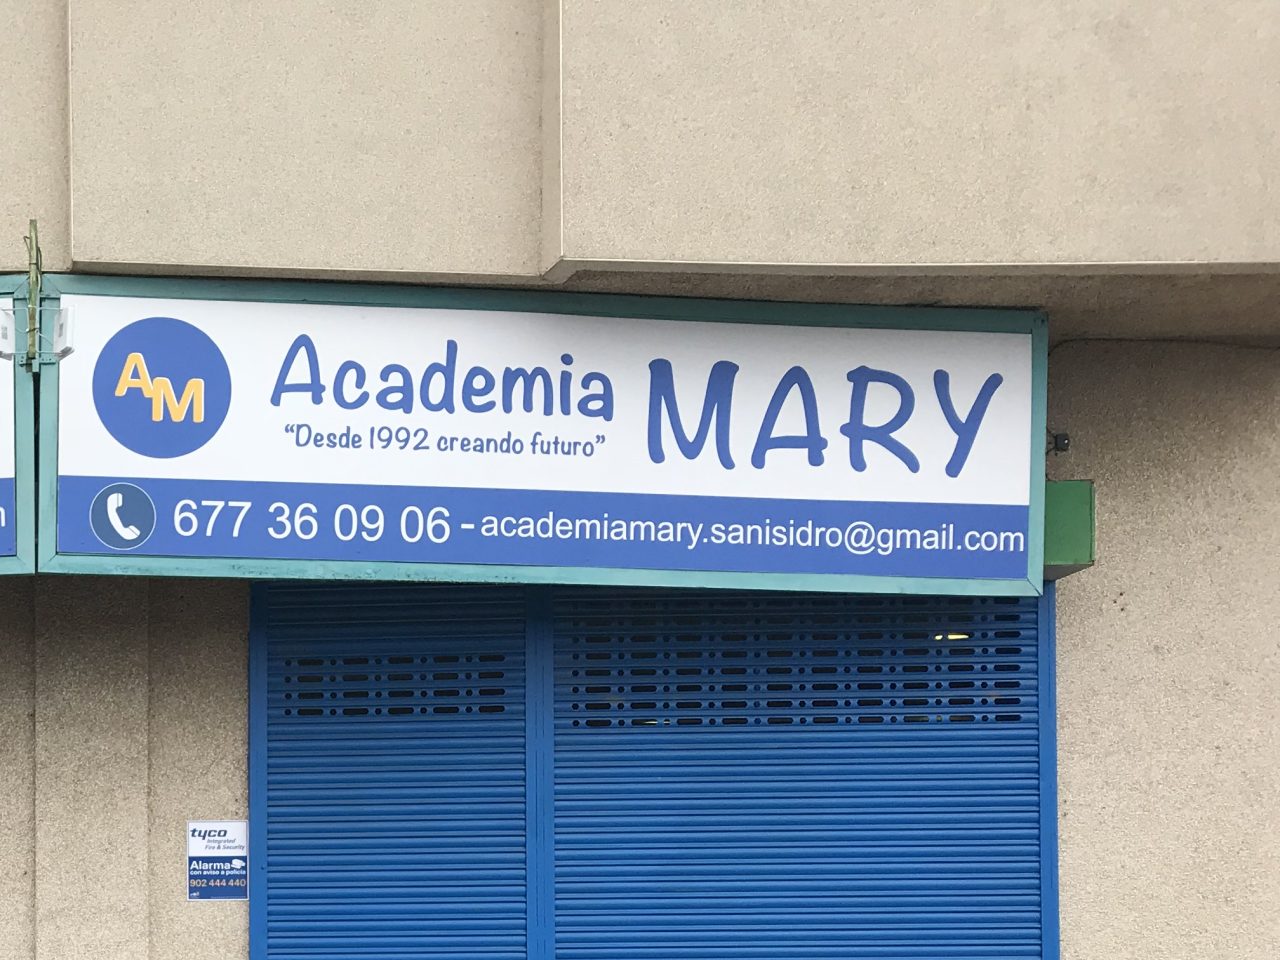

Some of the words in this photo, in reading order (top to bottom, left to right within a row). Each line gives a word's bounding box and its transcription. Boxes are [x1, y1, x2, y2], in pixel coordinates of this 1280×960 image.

[115, 352, 205, 423] AM
[270, 333, 614, 422] Academia
[647, 357, 1004, 479] MARY
[369, 426, 430, 451] 1992
[437, 431, 524, 455] creando
[173, 499, 252, 538] 677
[267, 501, 318, 540] 36
[334, 503, 385, 542] 09
[400, 505, 451, 544] 06
[480, 510, 1025, 556] academiamary.sanisidro@gmail.com
[190, 828, 228, 840] tyco
[190, 860, 231, 870] Alarma
[190, 879, 207, 887] 902
[209, 879, 226, 887] 444
[228, 879, 246, 887] 440
